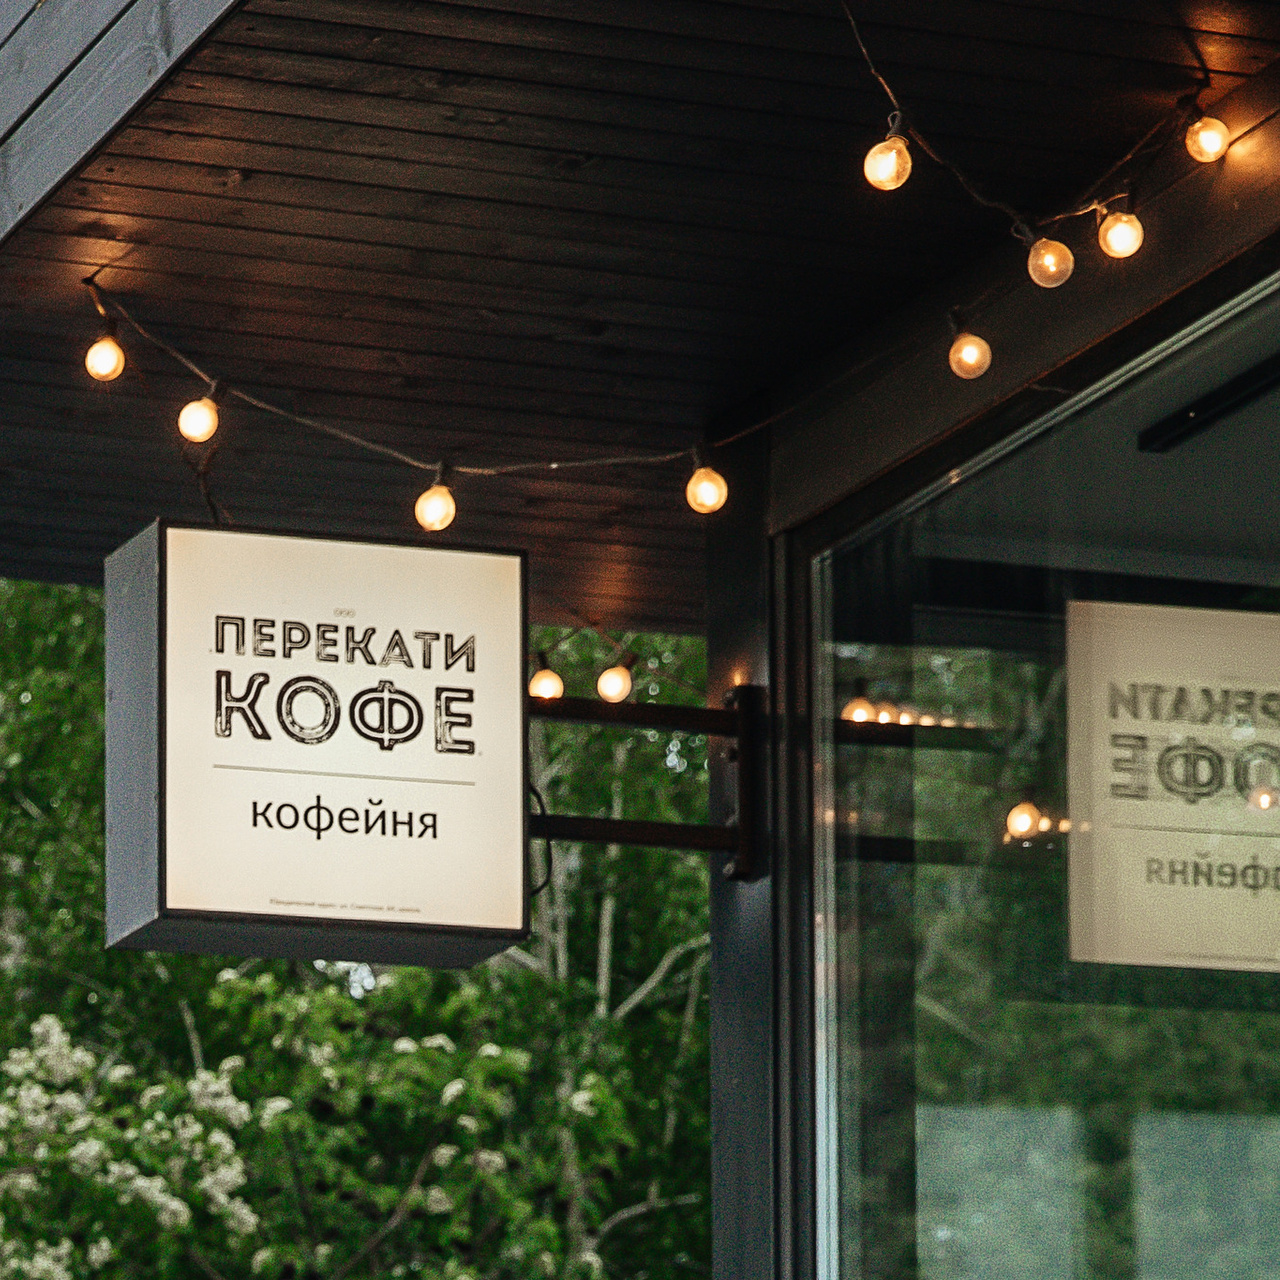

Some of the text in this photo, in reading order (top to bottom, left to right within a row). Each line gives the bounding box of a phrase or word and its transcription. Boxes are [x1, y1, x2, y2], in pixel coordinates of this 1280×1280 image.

[214, 615, 476, 673] ПЕРЕКАТИ
[214, 669, 476, 755] КОФЕ
[251, 794, 439, 840] кофейня
